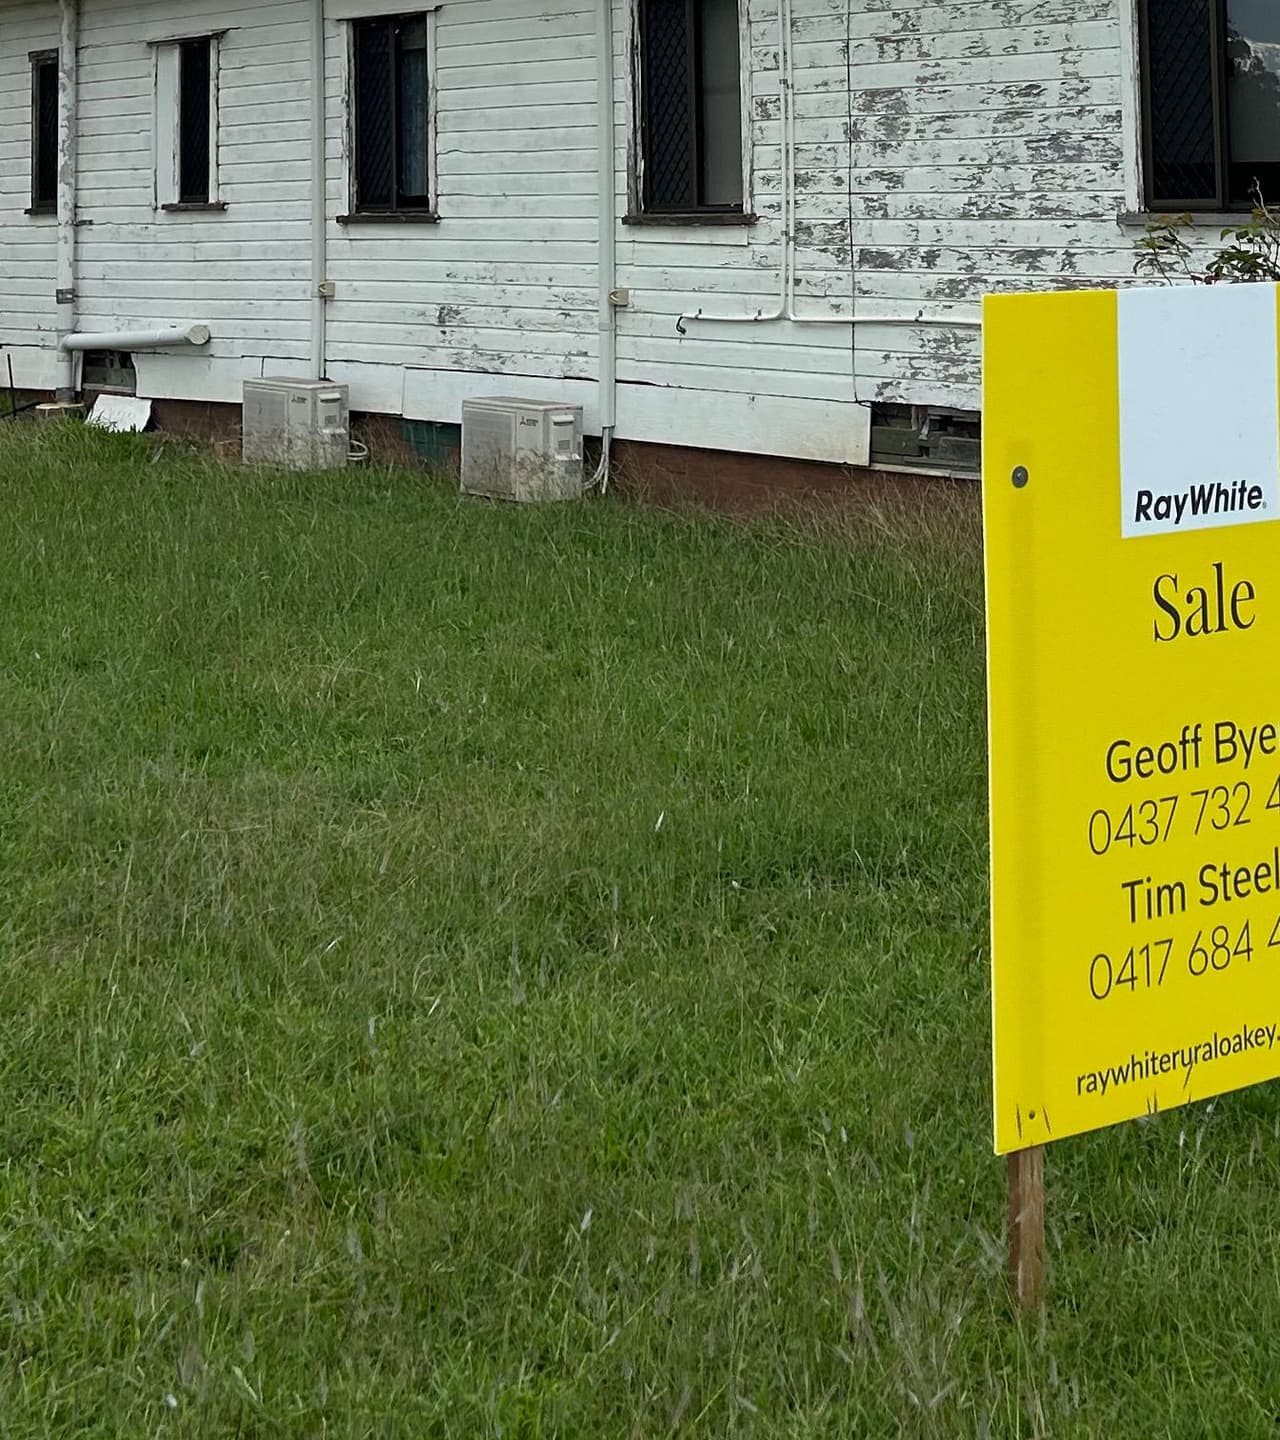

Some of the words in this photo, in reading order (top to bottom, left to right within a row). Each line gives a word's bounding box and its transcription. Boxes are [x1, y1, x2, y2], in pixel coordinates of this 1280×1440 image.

[1153, 562, 1256, 642] Sale
[1106, 723, 1203, 783] Geoff
[1088, 795, 1179, 856] 0437
[1190, 781, 1251, 835] 732
[1121, 876, 1186, 924] Tim
[1089, 938, 1173, 1000] 0417
[1188, 919, 1254, 976] 684
